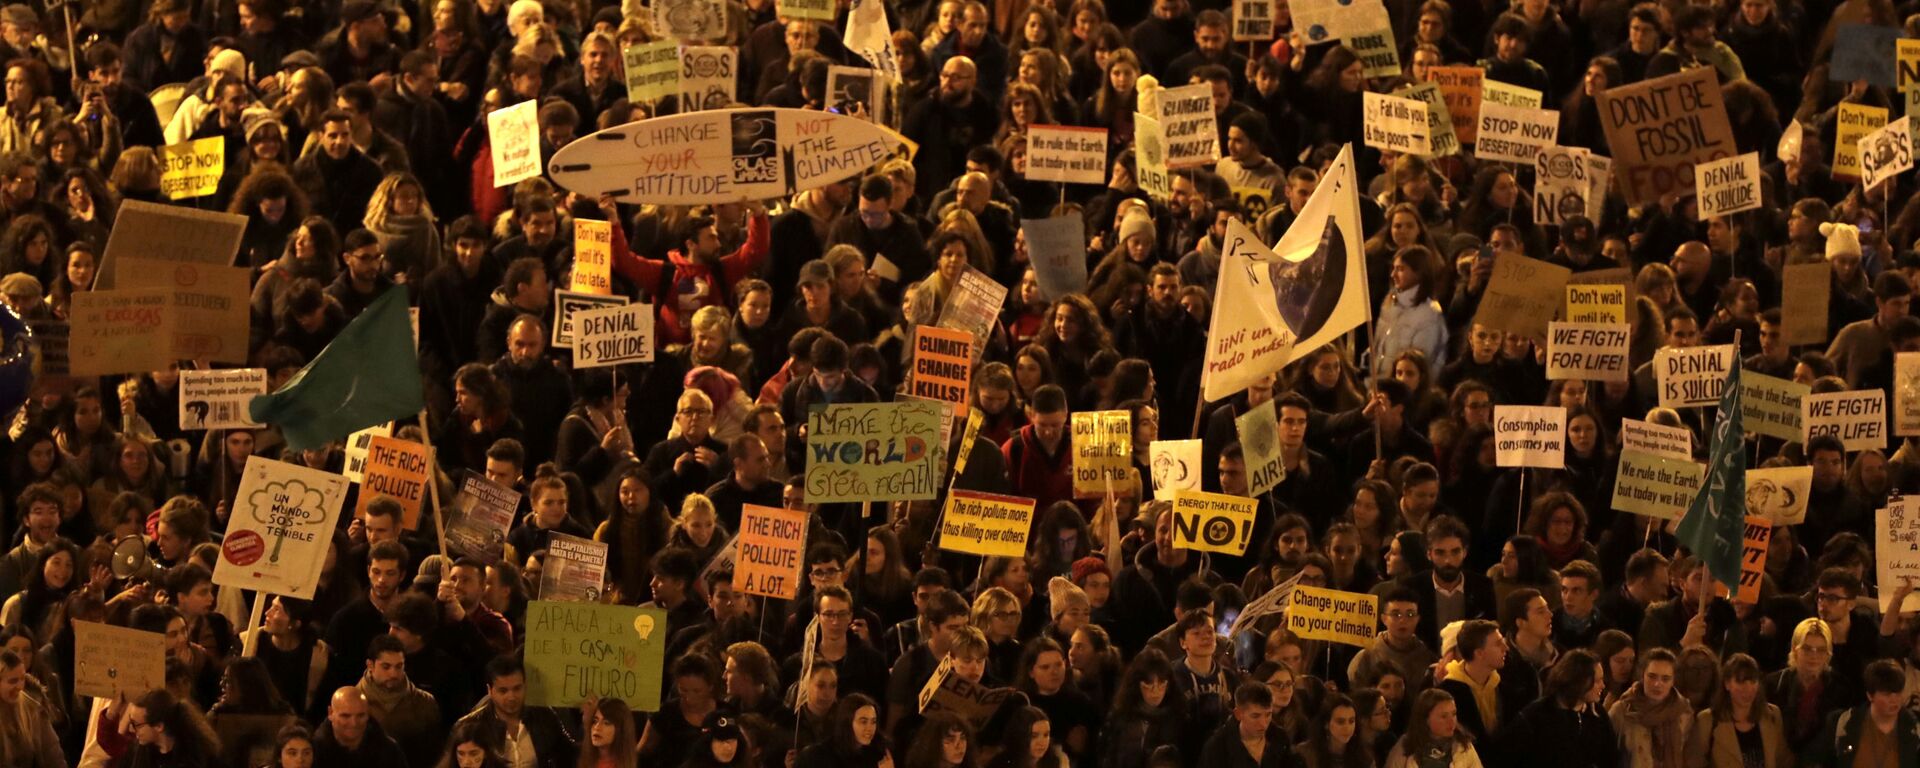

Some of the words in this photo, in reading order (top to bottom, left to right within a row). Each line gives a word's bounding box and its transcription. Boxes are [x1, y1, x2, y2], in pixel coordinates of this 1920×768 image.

[1163, 96, 1211, 117] CLIMATE
[1678, 79, 1713, 114] BE
[1380, 99, 1393, 118] Fat
[1394, 102, 1409, 120] kills
[1411, 107, 1425, 125] you
[1840, 109, 1864, 126] Don't
[634, 122, 720, 149] CHANGE
[796, 118, 838, 136] NOT
[1166, 118, 1213, 138] CAN'T
[1482, 117, 1519, 134] STOP
[1521, 122, 1554, 141] NOW
[800, 136, 838, 155] THE
[1032, 136, 1045, 150] We
[1047, 137, 1063, 151] rule
[1065, 138, 1079, 152] the
[1169, 139, 1214, 158] WAIT!
[1373, 126, 1385, 143] the
[1387, 131, 1409, 150] poors
[1637, 115, 1723, 162] FOSSIL
[162, 155, 193, 173] STOP
[196, 153, 221, 169] NOW
[642, 149, 701, 174] YOUR
[1031, 155, 1044, 168] but
[1046, 155, 1067, 170] today
[1069, 160, 1081, 170] we
[1083, 157, 1095, 171] kill
[1628, 150, 1729, 203] FOO
[1570, 288, 1598, 305] Don't
[1601, 290, 1623, 305] wait
[1251, 326, 1272, 345] un
[1553, 329, 1578, 346] WE
[1580, 330, 1626, 348] FIGTH
[919, 335, 970, 359] CLIMATE
[916, 358, 968, 382] CHANGE
[1550, 352, 1582, 369] FOR
[1584, 355, 1624, 371] LIFE!
[184, 375, 213, 386] Spending
[214, 376, 226, 384] too
[226, 375, 244, 383] much
[251, 373, 263, 382] bad
[185, 388, 193, 396] for
[207, 388, 227, 397] people
[228, 387, 239, 395] and
[915, 380, 966, 404] KILLS!
[1745, 386, 1763, 400] rule
[1765, 387, 1779, 401] the
[1809, 400, 1833, 418] WE
[1837, 397, 1883, 417] FIGTH
[812, 406, 881, 436] MAKE
[1106, 419, 1129, 435] wait
[1497, 415, 1559, 436] Consumption
[1767, 413, 1780, 423] we
[1780, 411, 1794, 426] kill
[1625, 423, 1649, 438] Spending
[1649, 429, 1658, 437] too
[1659, 430, 1673, 441] much
[1843, 421, 1882, 440] LIFE!
[809, 435, 928, 466] WORLD
[1498, 439, 1542, 452] consumes
[1625, 436, 1633, 444] for
[1643, 440, 1660, 451] people
[1660, 443, 1670, 451] and
[375, 445, 398, 466] THE
[397, 451, 427, 475] RICH
[1076, 468, 1097, 482] too
[1251, 456, 1284, 493] AIR!
[1621, 460, 1635, 477] We
[1637, 465, 1654, 480] rule
[1657, 467, 1672, 484] the
[366, 473, 421, 501] POLLUTE
[1617, 482, 1632, 498] but
[1634, 487, 1657, 505] today
[1659, 494, 1672, 504] we
[1673, 493, 1688, 508] kill
[273, 493, 290, 504] UN
[1177, 497, 1211, 510] ENERGY
[1211, 500, 1229, 511] THAT
[271, 504, 311, 520] MUNDO
[952, 499, 966, 515] The
[966, 500, 981, 517] rich
[981, 503, 1008, 521] pollute
[1008, 509, 1029, 523] more,
[266, 526, 315, 543] TENIBLE
[747, 514, 769, 536] THE
[772, 518, 801, 541] RICH
[942, 522, 960, 535] thus
[961, 523, 984, 543] killing
[984, 529, 1001, 540] over
[1001, 527, 1026, 544] others.
[1173, 512, 1252, 550] NO!
[549, 547, 567, 557] MATA
[567, 550, 574, 559] EL
[561, 541, 605, 557] CAPITALISMO
[741, 542, 797, 569] POLLUTE
[745, 572, 754, 591] A
[759, 575, 785, 596] LOT.
[1293, 589, 1332, 612] Change
[1333, 599, 1356, 614] your
[1359, 600, 1377, 618] life,
[535, 605, 600, 633] APAGA
[1291, 614, 1306, 627] no
[1308, 618, 1332, 633] your
[1334, 619, 1375, 639] climate.
[532, 640, 554, 655] DE
[562, 664, 637, 698] FUTURO
